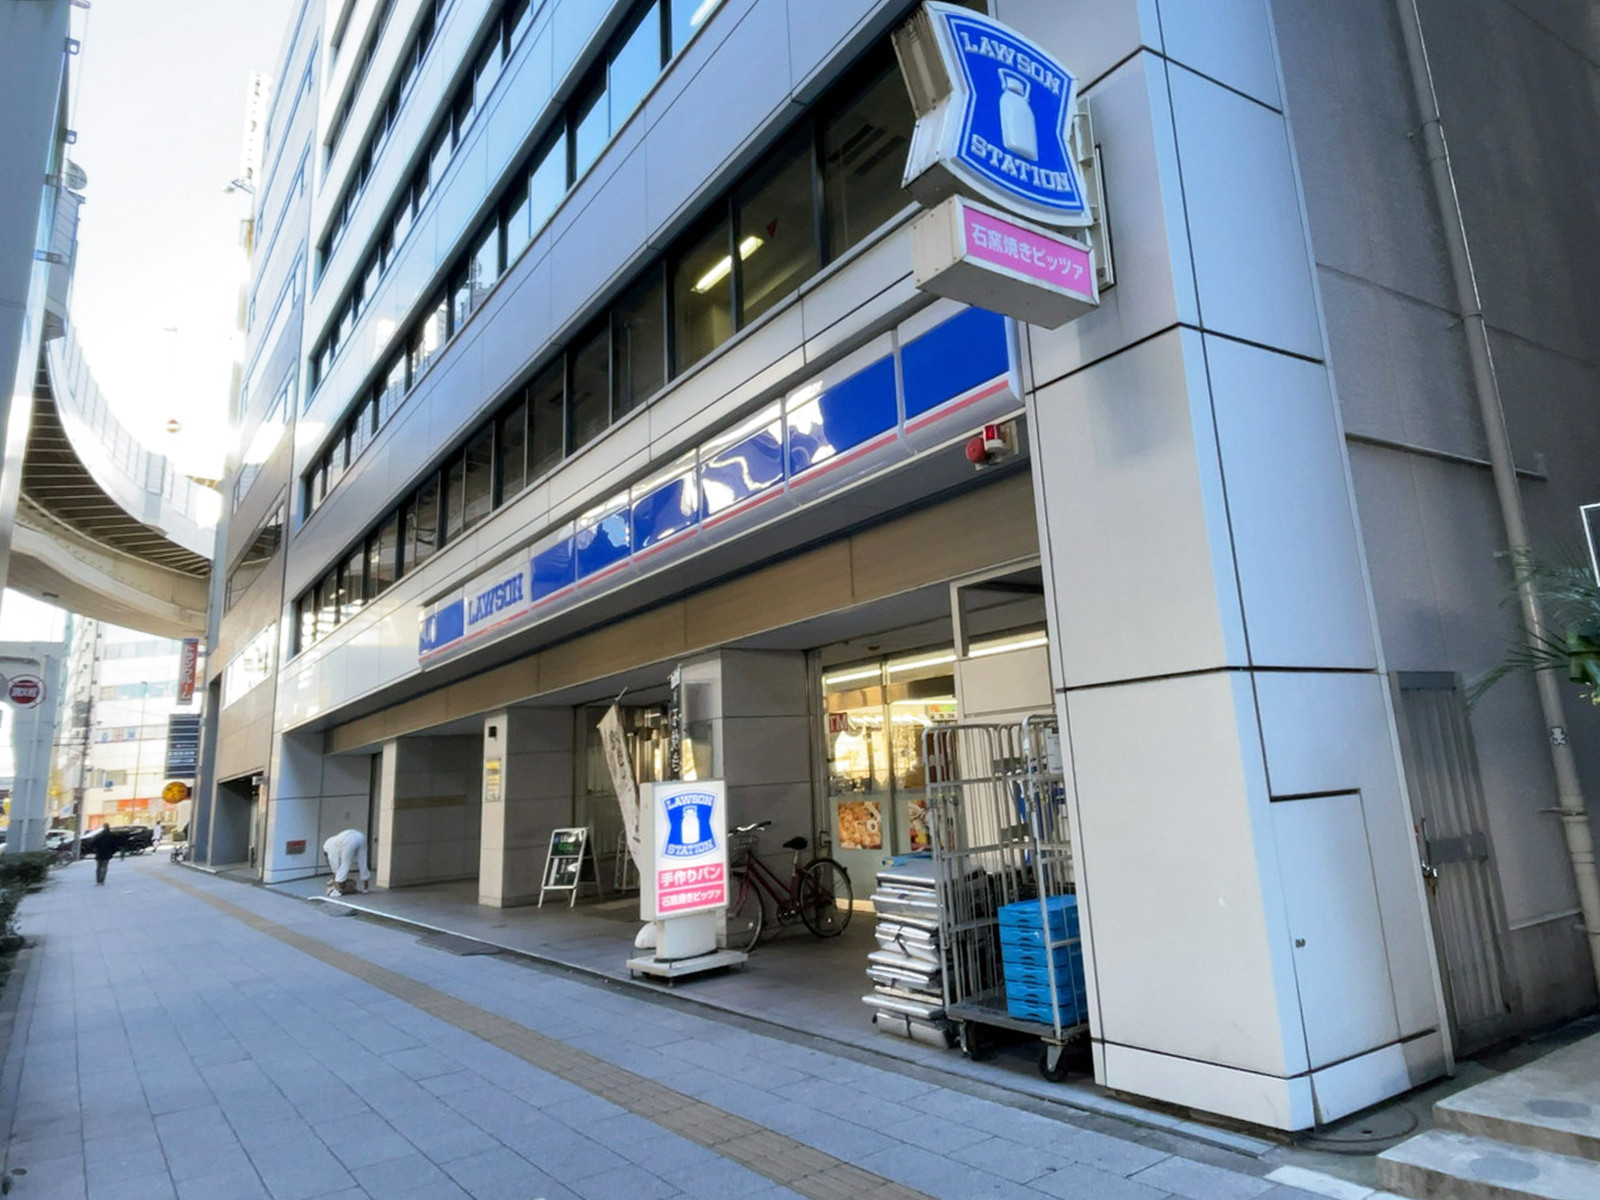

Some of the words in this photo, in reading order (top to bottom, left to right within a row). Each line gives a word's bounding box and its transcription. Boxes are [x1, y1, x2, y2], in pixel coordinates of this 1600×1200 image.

[960, 31, 1062, 96] LAWSON
[970, 133, 1073, 193] STATION
[971, 222, 1084, 280] 石窯焼きピッツァ
[468, 572, 524, 626] LAWSON
[665, 794, 715, 810] LAWSON
[666, 841, 715, 856] STATION
[660, 866, 721, 888] 手作りパン
